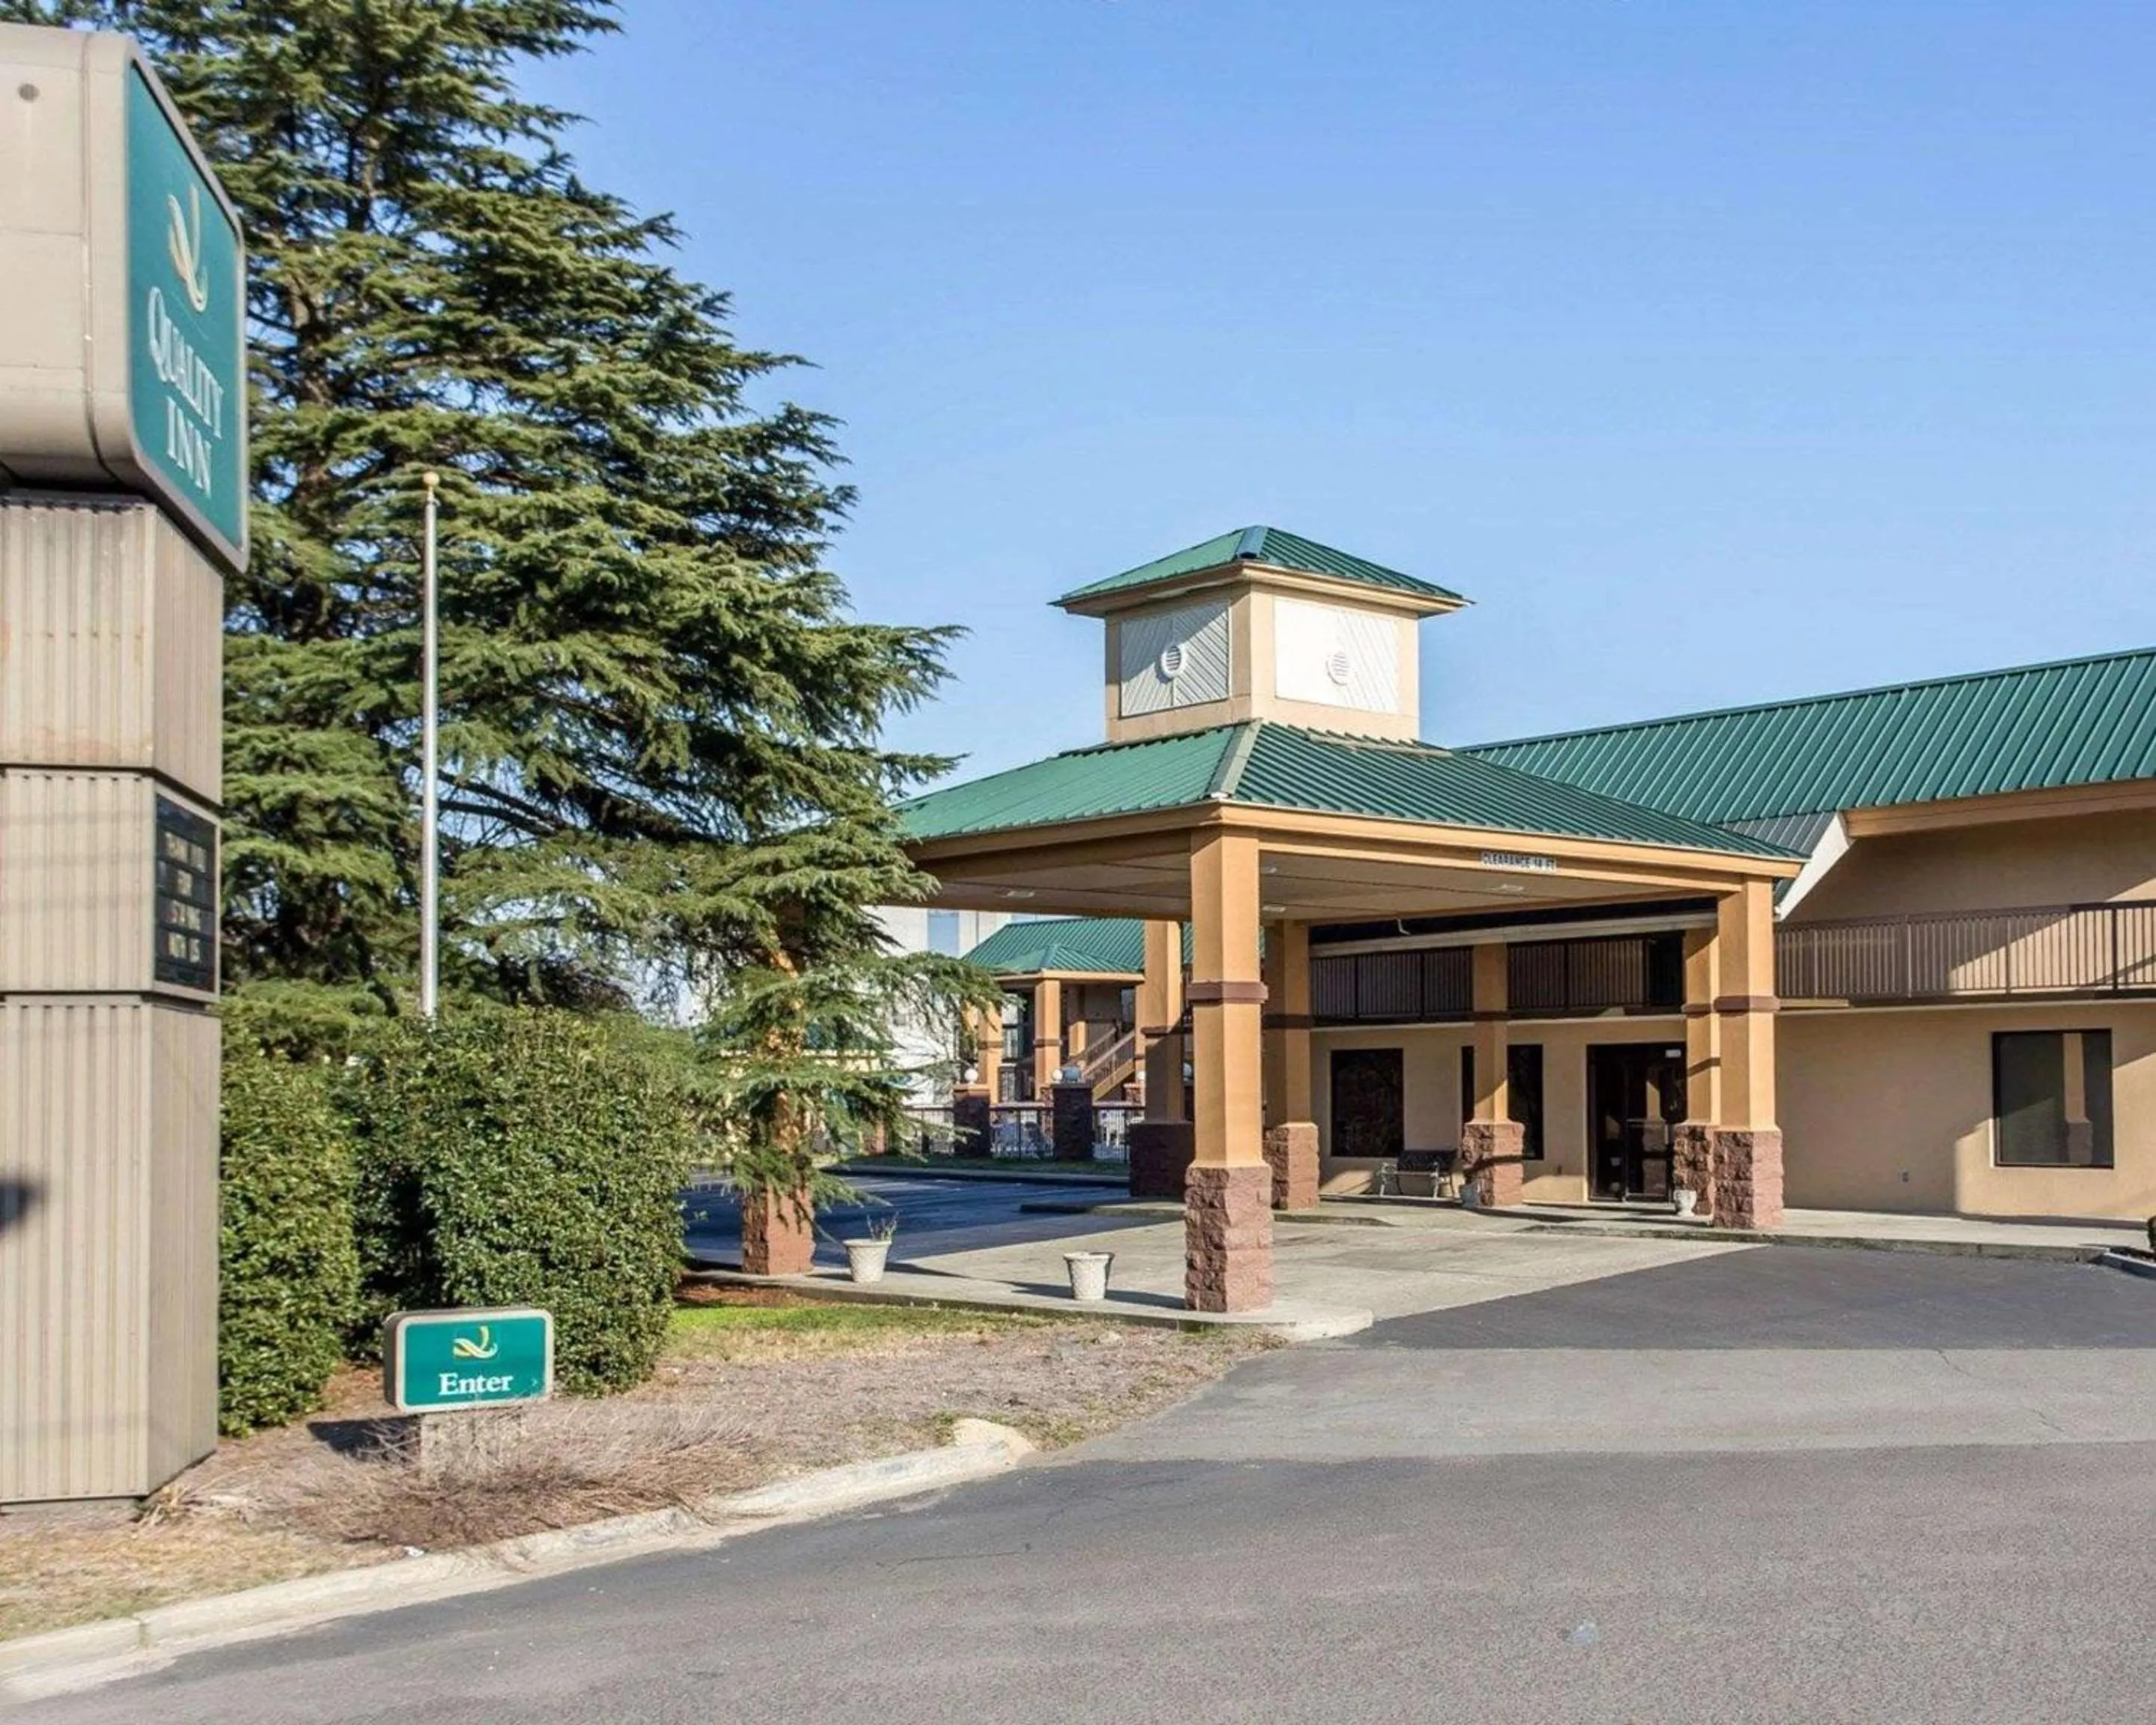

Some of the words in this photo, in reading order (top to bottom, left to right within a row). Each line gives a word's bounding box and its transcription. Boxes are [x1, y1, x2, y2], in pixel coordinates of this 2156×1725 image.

[148, 286, 224, 439] QUALITY
[165, 395, 212, 499] INN
[1482, 852, 1530, 868] CLEARANCE
[438, 1372, 514, 1396] Enter
